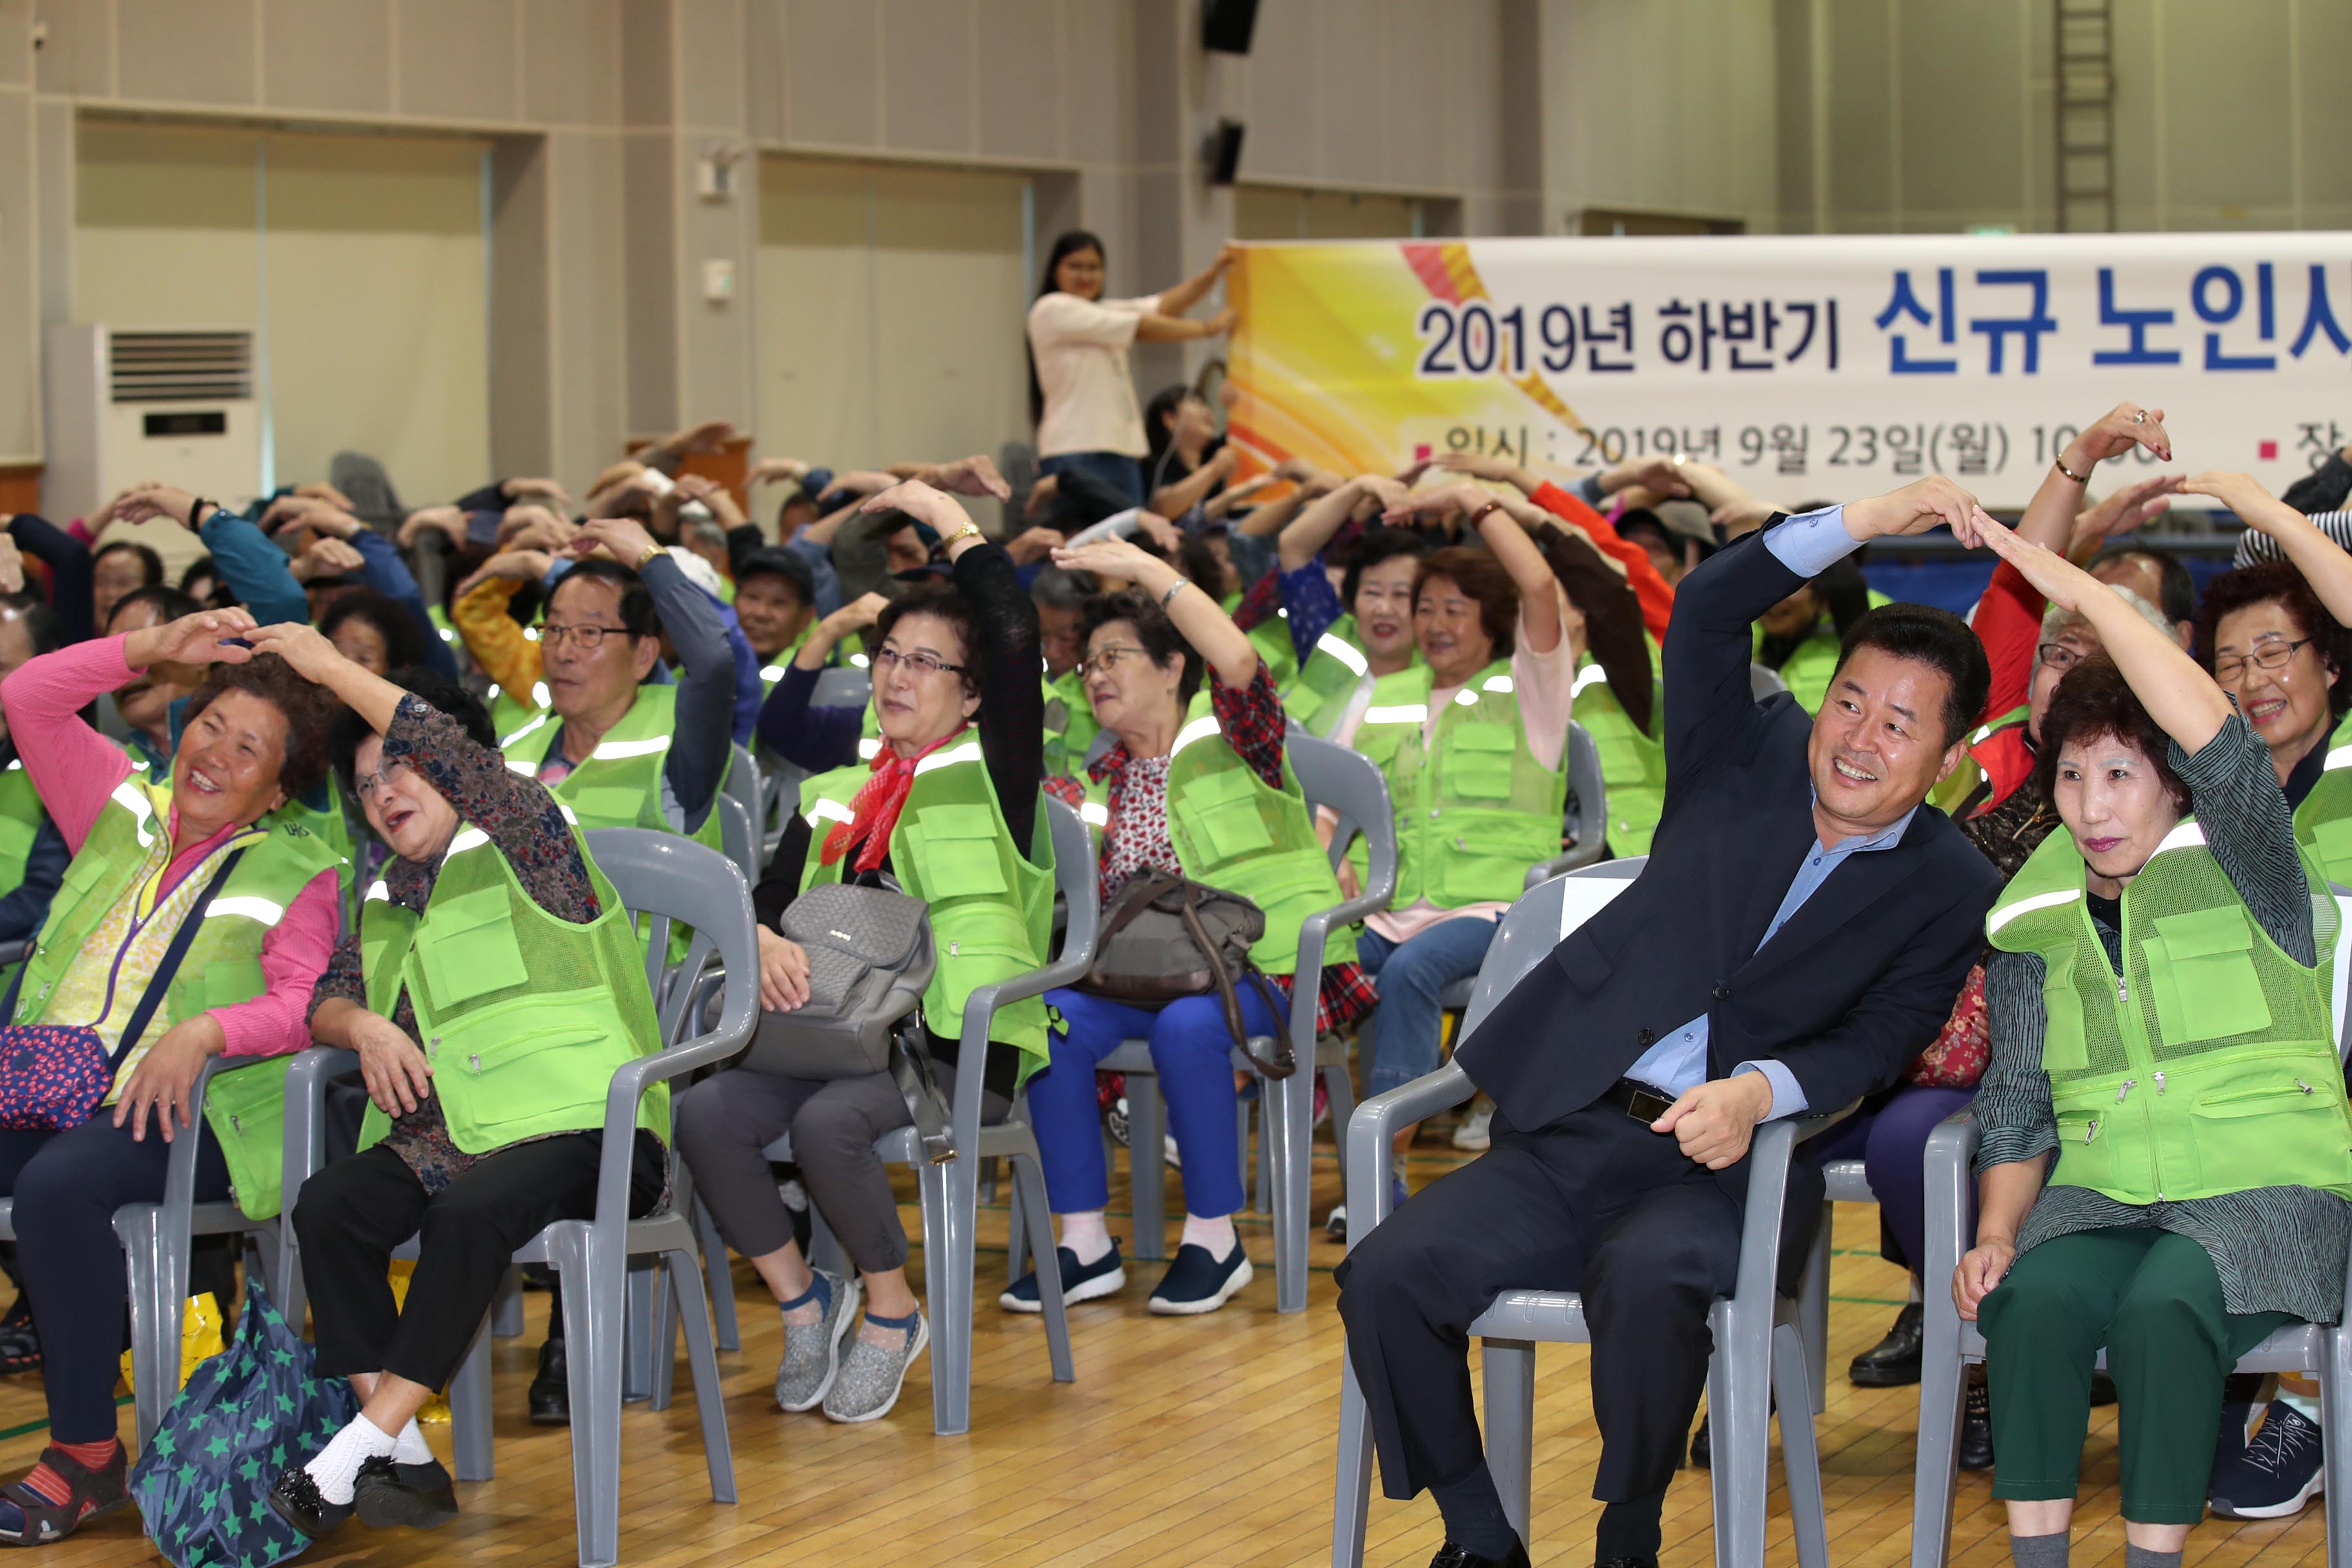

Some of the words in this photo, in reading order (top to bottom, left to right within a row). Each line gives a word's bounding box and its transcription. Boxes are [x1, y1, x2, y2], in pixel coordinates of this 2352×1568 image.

[1420, 302, 1634, 373] 2019년
[1658, 299, 1838, 371] 하반기
[1874, 267, 2057, 375] 신규
[1575, 426, 1721, 466] 2019년
[1739, 424, 1808, 475] 9월
[1827, 423, 2009, 475] 23일(월)
